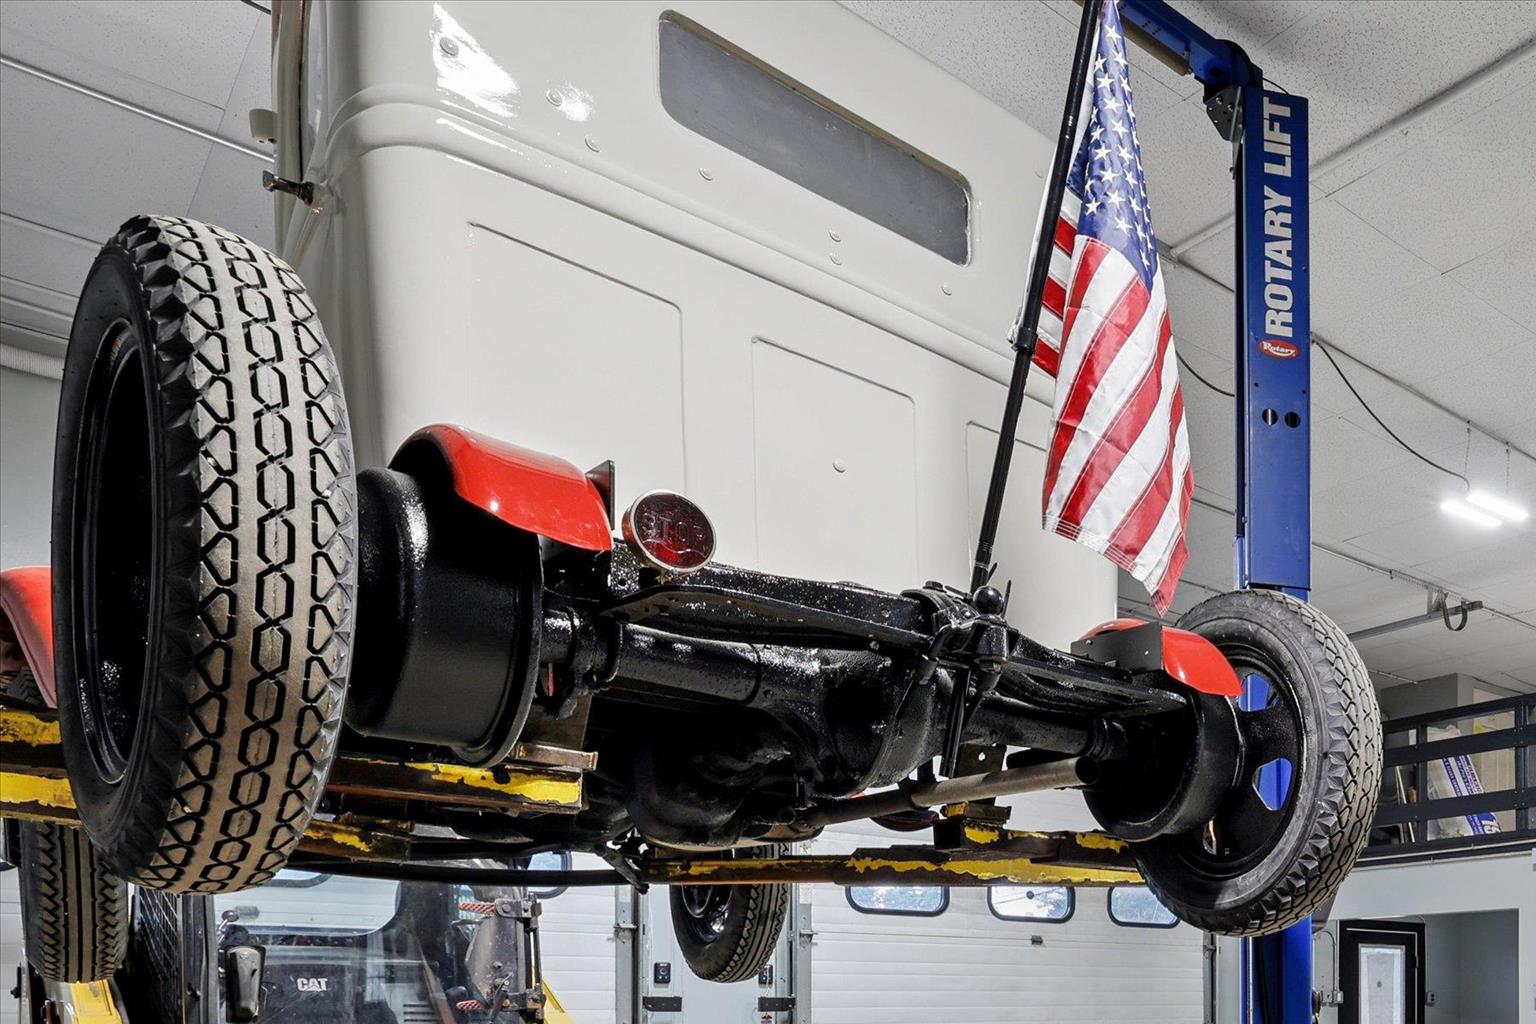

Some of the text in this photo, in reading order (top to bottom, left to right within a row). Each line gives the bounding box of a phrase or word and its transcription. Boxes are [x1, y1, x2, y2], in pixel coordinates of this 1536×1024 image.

[1263, 97, 1293, 337] ROTARY LIFT
[1263, 341, 1296, 356] Rotary
[297, 978, 328, 992] CAT
